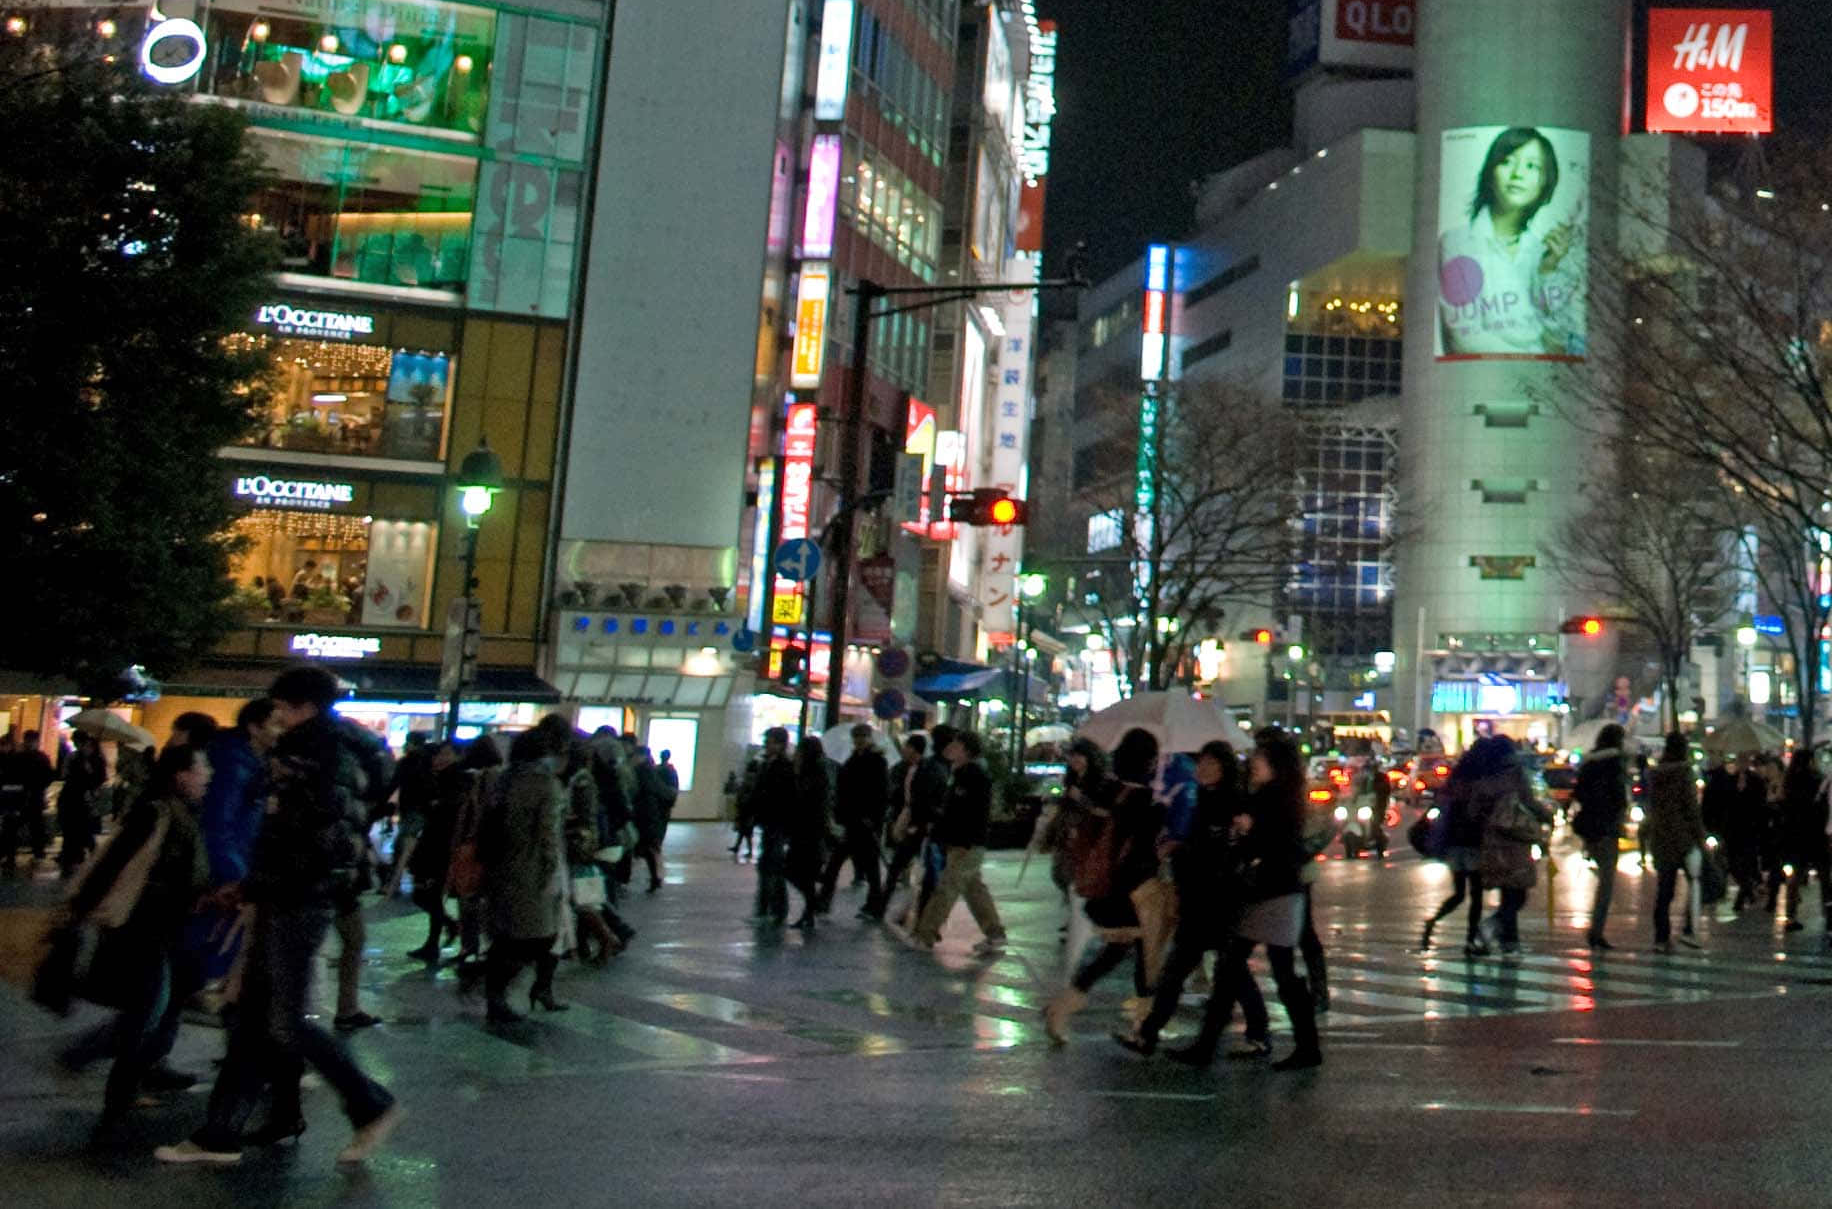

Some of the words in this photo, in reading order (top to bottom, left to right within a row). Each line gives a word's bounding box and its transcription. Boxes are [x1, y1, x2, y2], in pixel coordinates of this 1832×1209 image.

[1672, 22, 1749, 73] H&M
[258, 304, 374, 334] L'OCCITANE
[236, 475, 354, 502] L'OCCITANE
